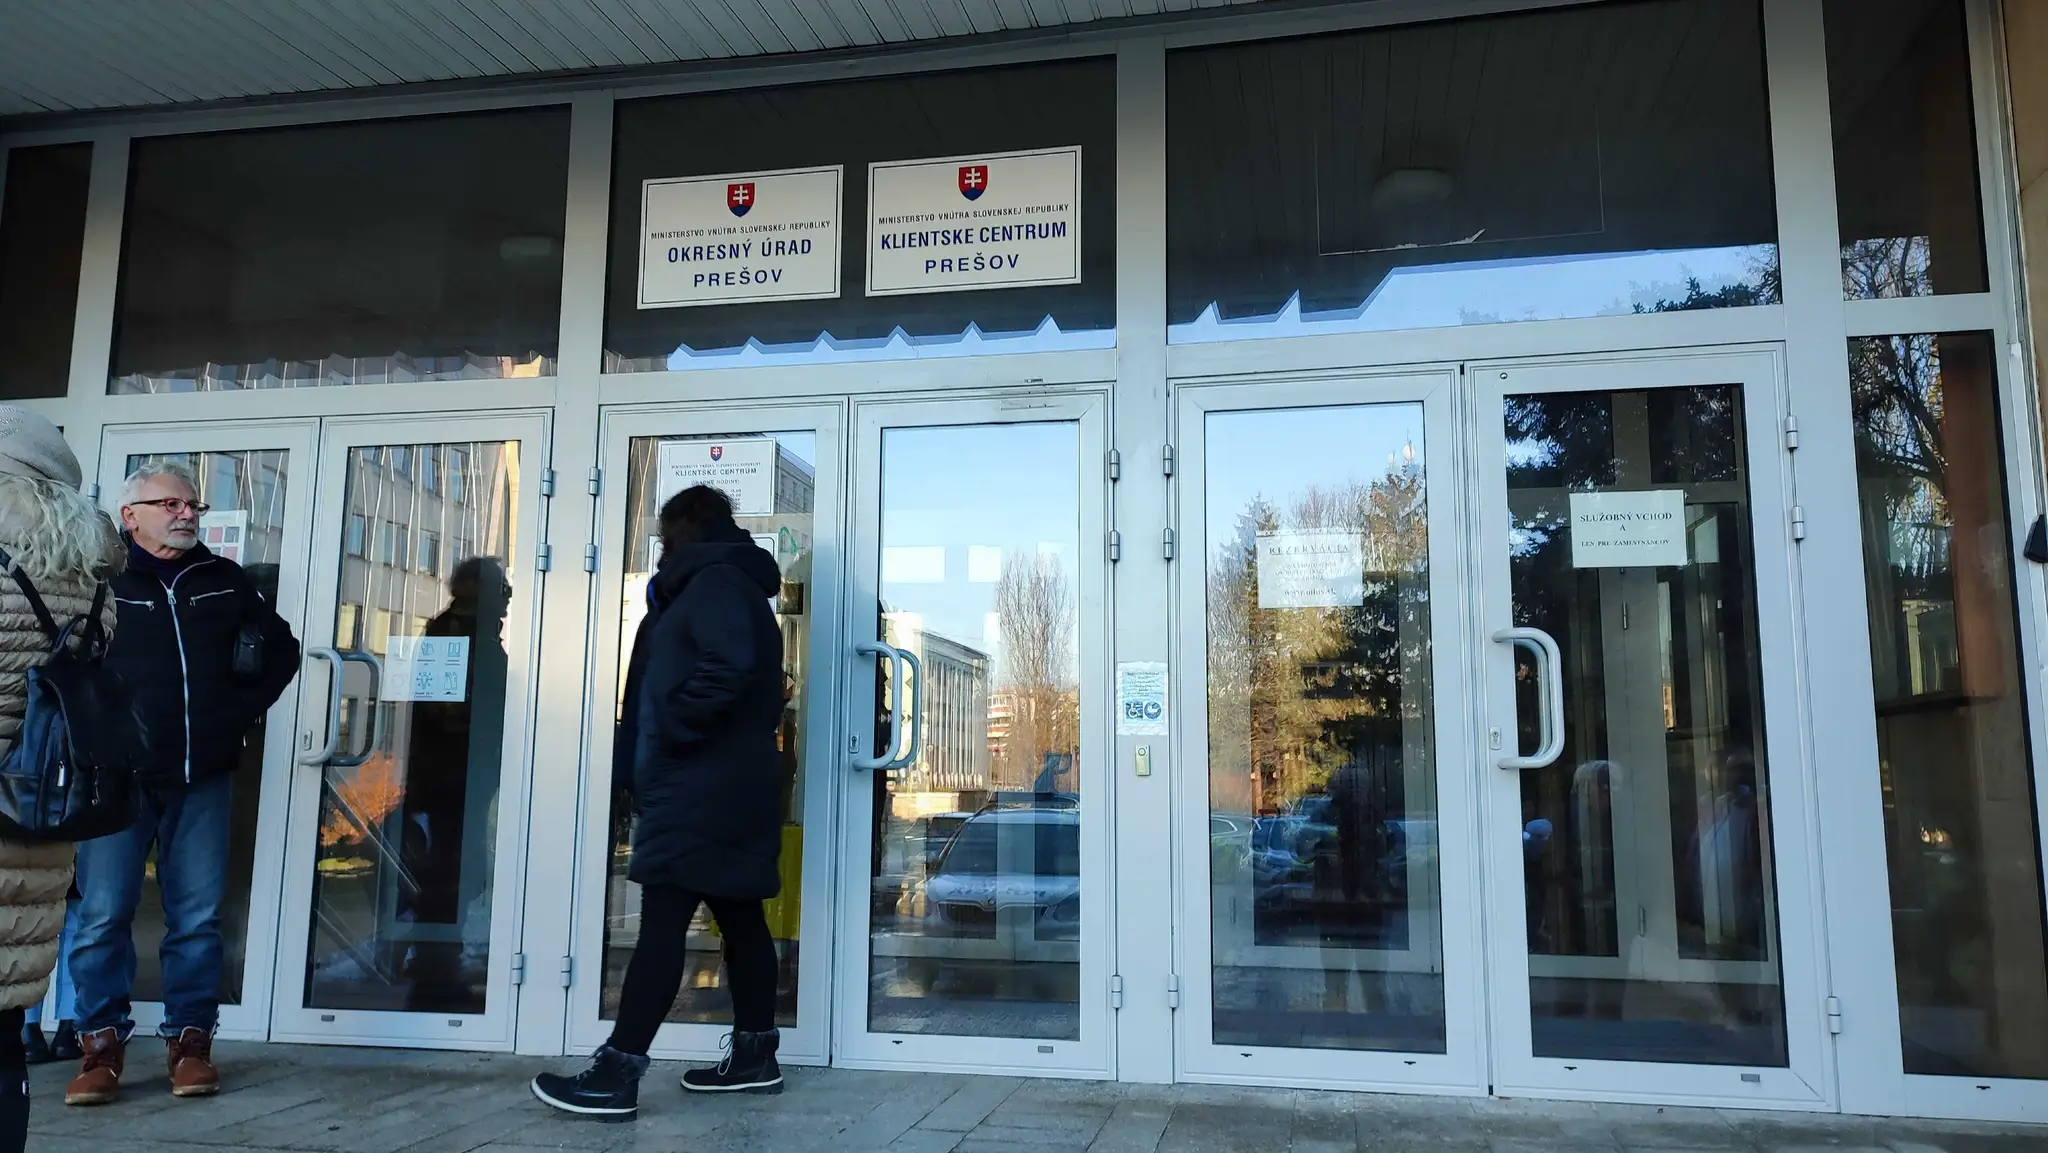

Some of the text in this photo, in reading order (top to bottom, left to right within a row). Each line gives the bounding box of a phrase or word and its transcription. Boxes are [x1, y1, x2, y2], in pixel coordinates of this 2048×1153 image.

[878, 203, 1069, 225] MINISTERSTVO VNÚTRA SLOVENSKEJ REPUBLIKY
[651, 220, 831, 240] MINISTERSTVO VNÚTRA SLOVENSKEJ REPUBLIKY
[881, 221, 1067, 250] KLIENTSKE CENTRUM
[668, 237, 812, 263] OKRESNÝ ÚRAD
[925, 252, 1019, 274] PREŠOV
[693, 266, 783, 288] PREŠOV
[675, 467, 757, 477] KLIENTSKE CENTRUM
[1580, 511, 1672, 522] SLUŽOBNÝ VCHOD
[1269, 543, 1349, 554] REZERVÁCIA
